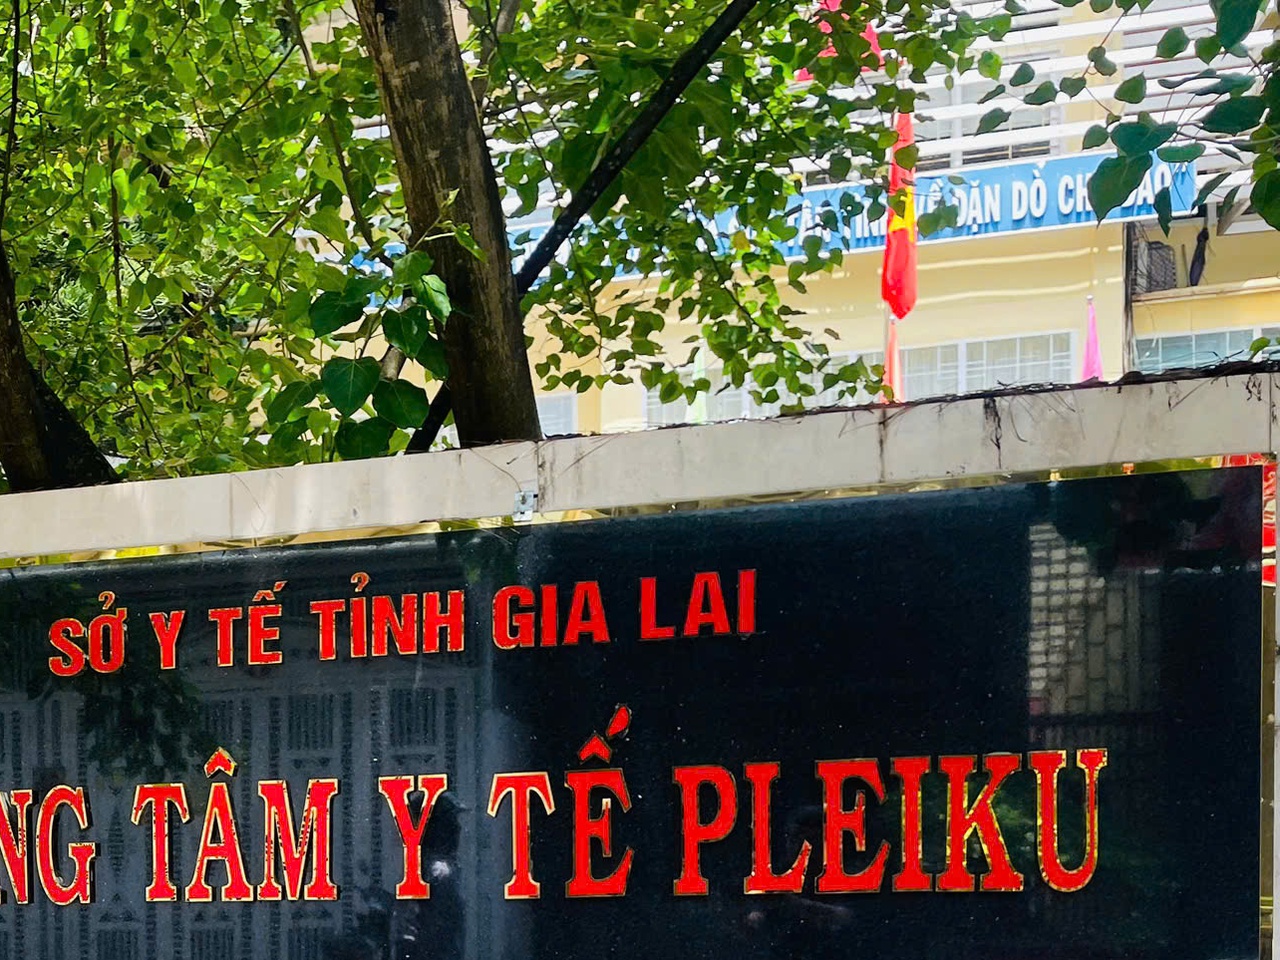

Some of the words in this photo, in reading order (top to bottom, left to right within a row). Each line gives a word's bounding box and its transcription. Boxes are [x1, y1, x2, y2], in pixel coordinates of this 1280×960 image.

[1012, 169, 1047, 219] DÒ
[49, 590, 128, 677] SỞ
[149, 610, 186, 670] Y
[208, 580, 284, 667] TẾ
[310, 571, 465, 660] TỈNH
[493, 581, 610, 650] GIA
[640, 569, 756, 641] LAI
[132, 746, 339, 902] TÂM
[378, 774, 448, 900] Y
[487, 703, 634, 899] TẾ
[672, 748, 1109, 896] PLEIKU
